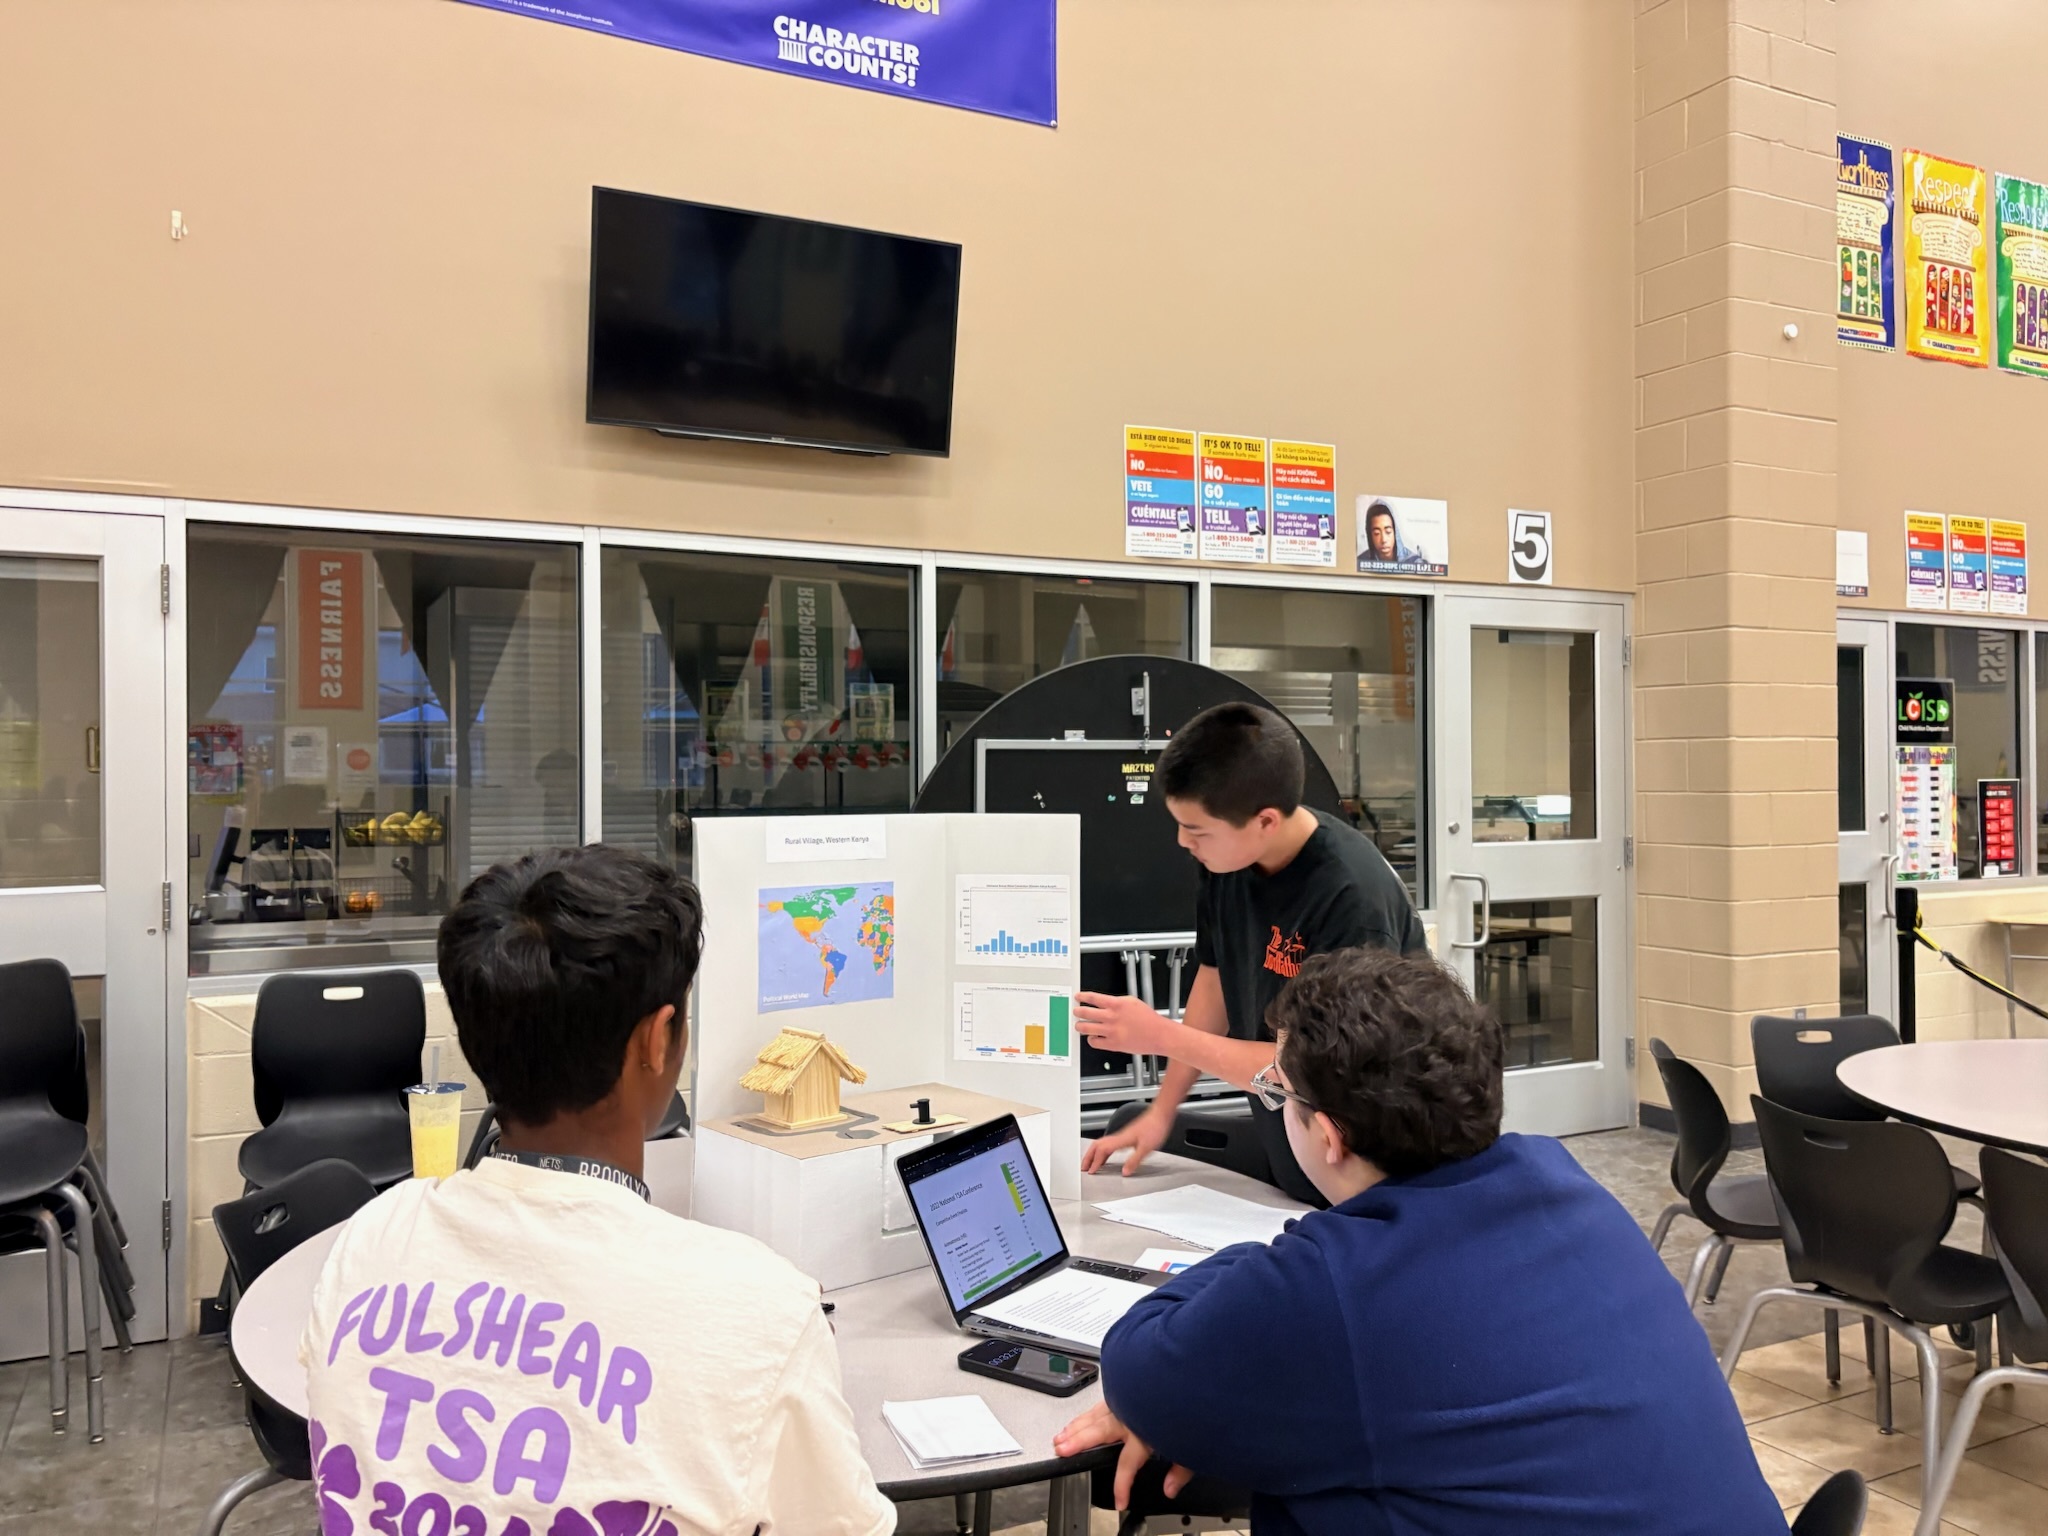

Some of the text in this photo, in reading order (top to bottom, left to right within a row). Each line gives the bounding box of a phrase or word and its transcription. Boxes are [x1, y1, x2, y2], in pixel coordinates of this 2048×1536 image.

[523, 2, 549, 12] trademark
[773, 15, 920, 66] CHARACTER
[808, 46, 916, 87] COUNTS!
[1914, 161, 1976, 210] Respect
[1130, 432, 1142, 440] ESTÁ
[1204, 439, 1261, 452] IT'S OK TO TELL!
[1130, 459, 1145, 471] NO
[1204, 464, 1223, 480] NO
[1130, 480, 1152, 492] VETE
[1204, 483, 1223, 499] GO
[1131, 504, 1176, 520] CUÉNTALE
[1204, 509, 1231, 525] TELL
[1512, 513, 1549, 581] 5
[1952, 539, 1964, 551] NO
[1952, 552, 1964, 564] GO
[1953, 572, 1968, 584] TELL
[1898, 698, 1950, 721] LCISD
[785, 837, 801, 845] Rural
[539, 1157, 562, 1170] NETS
[579, 1161, 647, 1199] BROOKLYN
[939, 1195, 955, 1207] National
[955, 1191, 963, 1199] TSA
[962, 1183, 983, 1196] Conference
[327, 1281, 652, 1445] FULSHEAR
[369, 1367, 571, 1503] TSA
